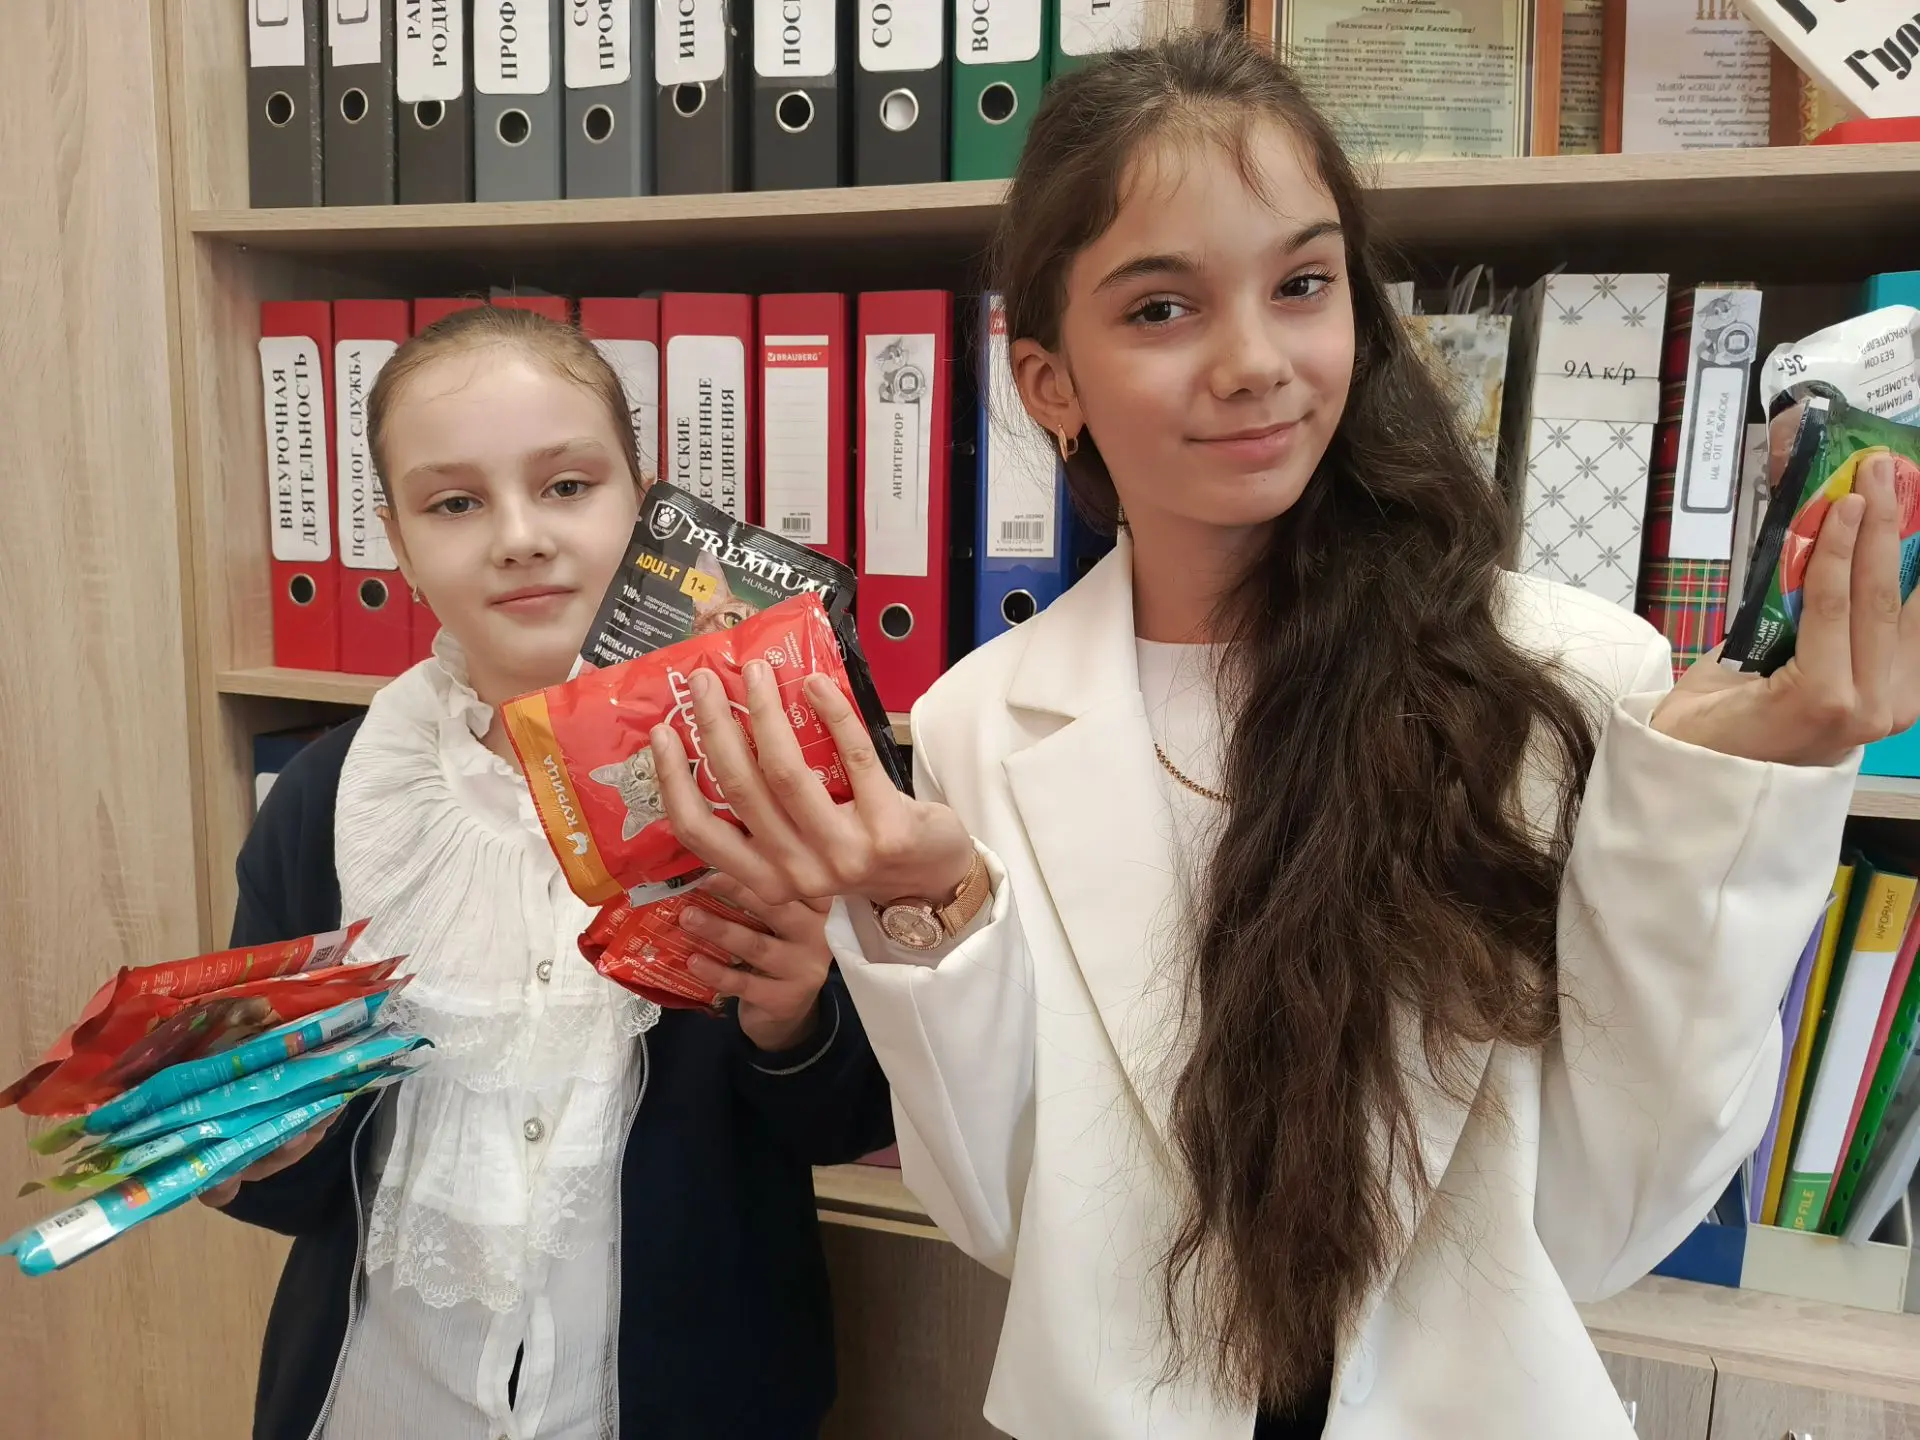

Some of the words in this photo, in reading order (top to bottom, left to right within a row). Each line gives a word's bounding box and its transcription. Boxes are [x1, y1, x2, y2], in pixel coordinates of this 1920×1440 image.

[406, 0, 421, 39] РА
[783, 0, 801, 66] ПОС
[499, 1, 518, 80] ПРОФ
[1564, 360, 1594, 379] 9А
[1602, 361, 1636, 385] к/р
[1864, 354, 1880, 370] СОИ
[1880, 348, 1896, 363] БЕЗ
[349, 350, 364, 438] СЛУЖБА
[1874, 390, 1914, 415] ВИТАМИН
[272, 368, 294, 530] ВНЕУРОЧНАЯ
[294, 353, 319, 547] ДЕЯТЕЛЬНОСТЬ
[677, 416, 691, 493] ЕТСКИЕ
[699, 377, 713, 503] ЕСТВЕННЫЕ
[721, 388, 736, 516] ЪЕДИНЕНИЯ
[892, 412, 905, 500] АНТИТЕРРОР
[635, 552, 680, 581] ADULT
[689, 576, 707, 593] 1+
[682, 524, 833, 600] PREMIUM
[623, 584, 641, 602] 100%
[742, 576, 782, 599] HUMAN
[633, 624, 651, 637] состав
[636, 619, 673, 640] натуральный
[1754, 620, 1780, 661] PREMIUM
[787, 701, 806, 729] 100%
[542, 754, 579, 828] КУРИЦА
[830, 764, 841, 779] БЕЗ
[1876, 888, 1896, 939] INFORMAT
[1799, 1189, 1815, 1216] FILE
